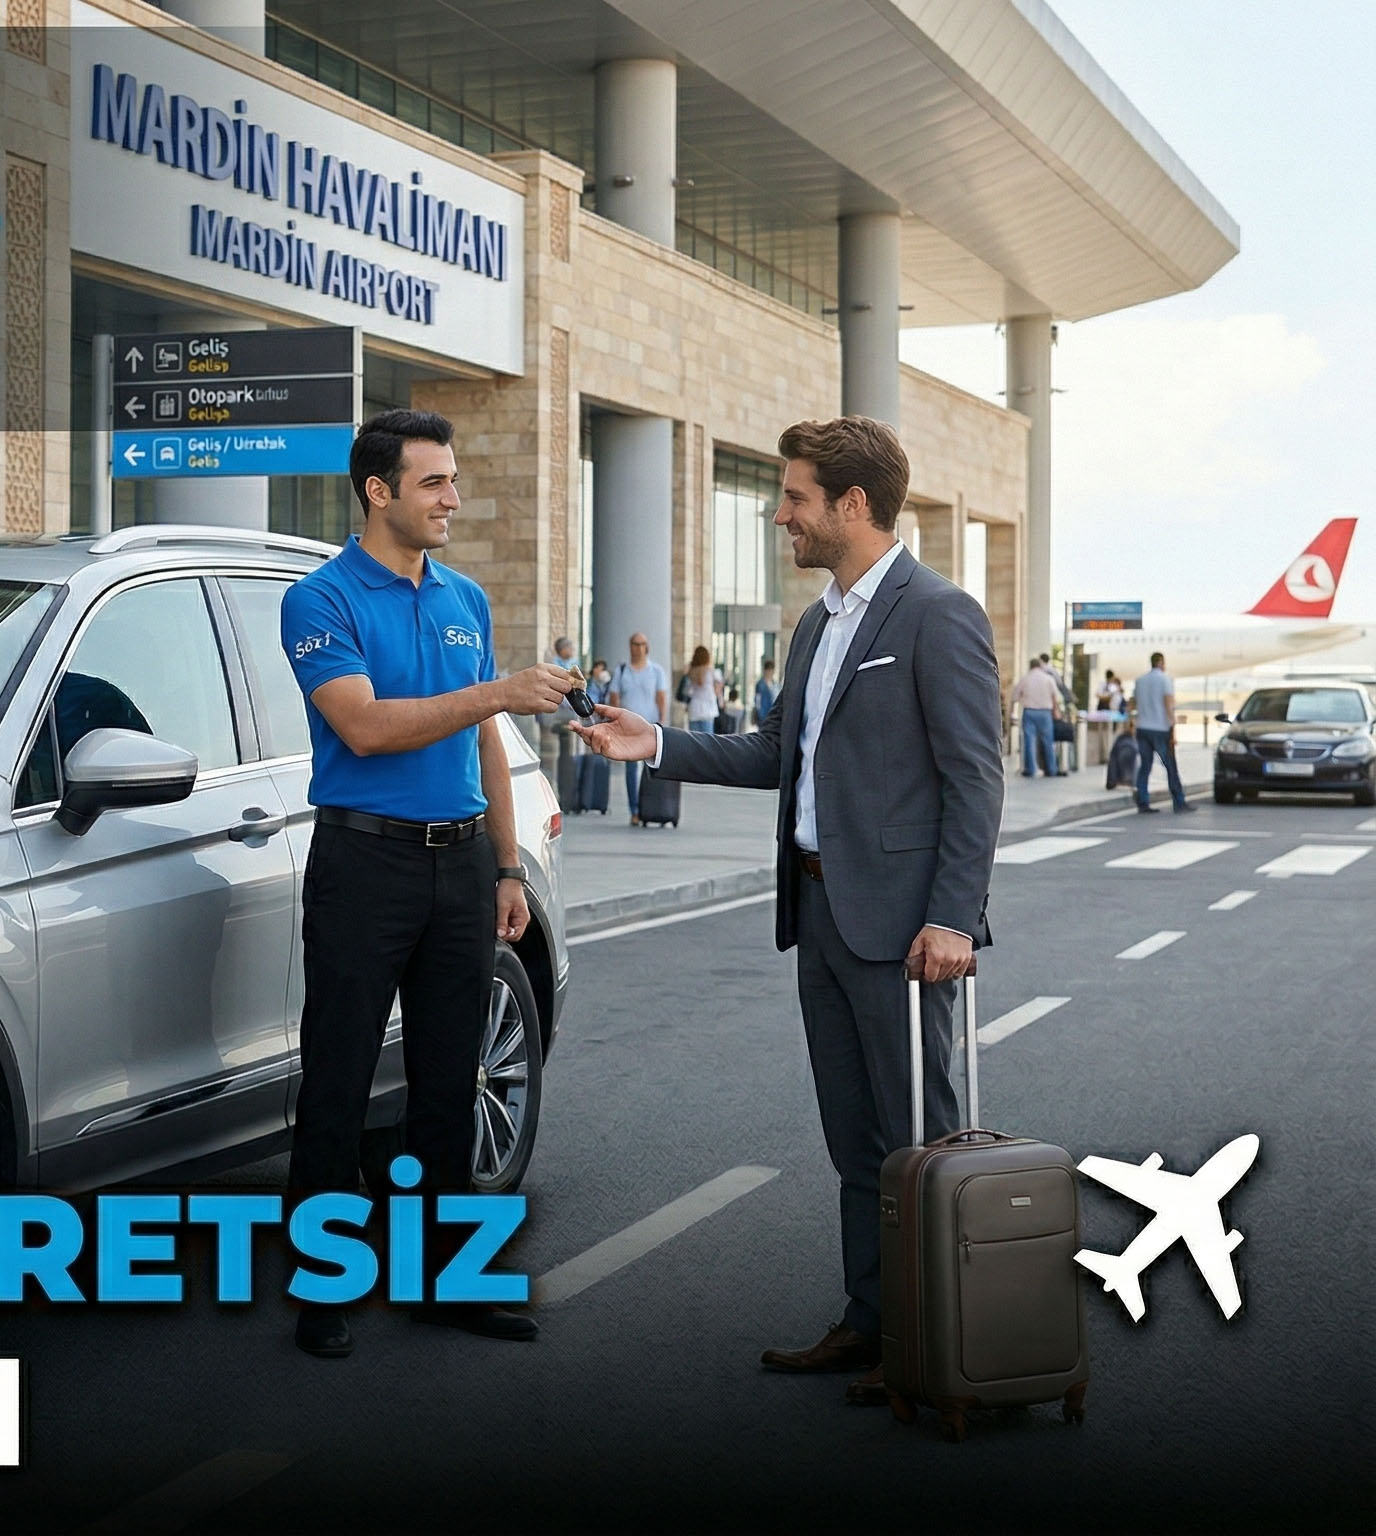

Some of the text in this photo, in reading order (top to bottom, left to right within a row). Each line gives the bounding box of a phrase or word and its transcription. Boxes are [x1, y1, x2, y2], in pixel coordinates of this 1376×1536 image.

[91, 63, 508, 282] MARDİN HAVALİMANI
[190, 203, 440, 325] MARDİN AIRPORT
[188, 384, 254, 408] Otopark
